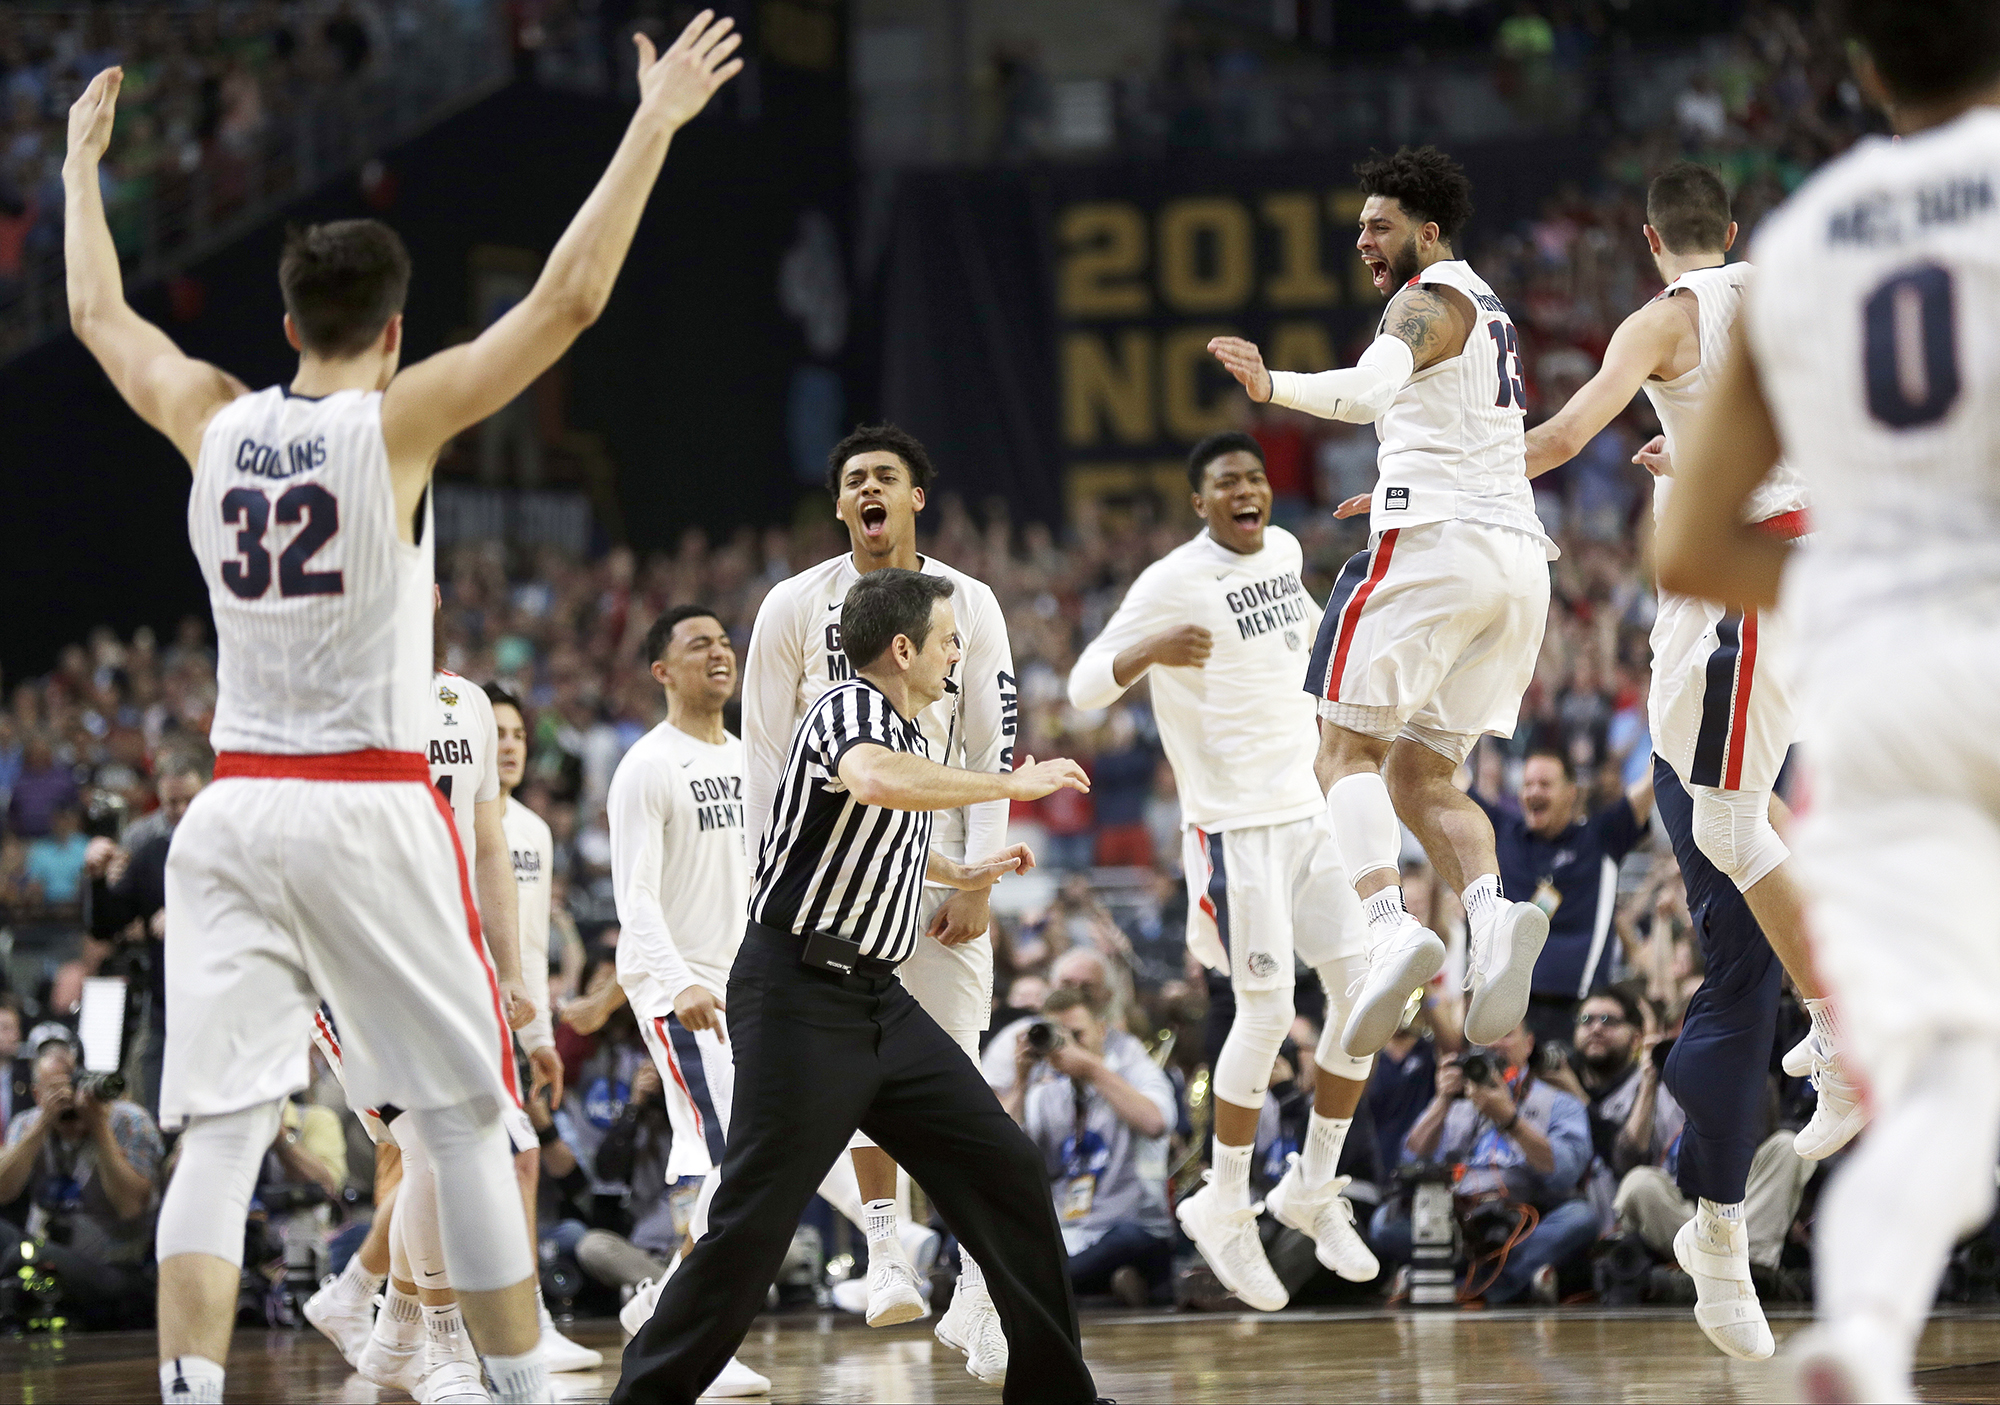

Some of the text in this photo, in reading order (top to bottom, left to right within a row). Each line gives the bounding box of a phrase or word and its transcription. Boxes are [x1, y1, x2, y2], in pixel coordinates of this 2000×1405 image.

[1487, 320, 1528, 410] 13
[1863, 261, 1960, 430] 0
[1390, 489, 1404, 497] 50
[222, 482, 344, 600] 32
[428, 739, 473, 765] AGA
